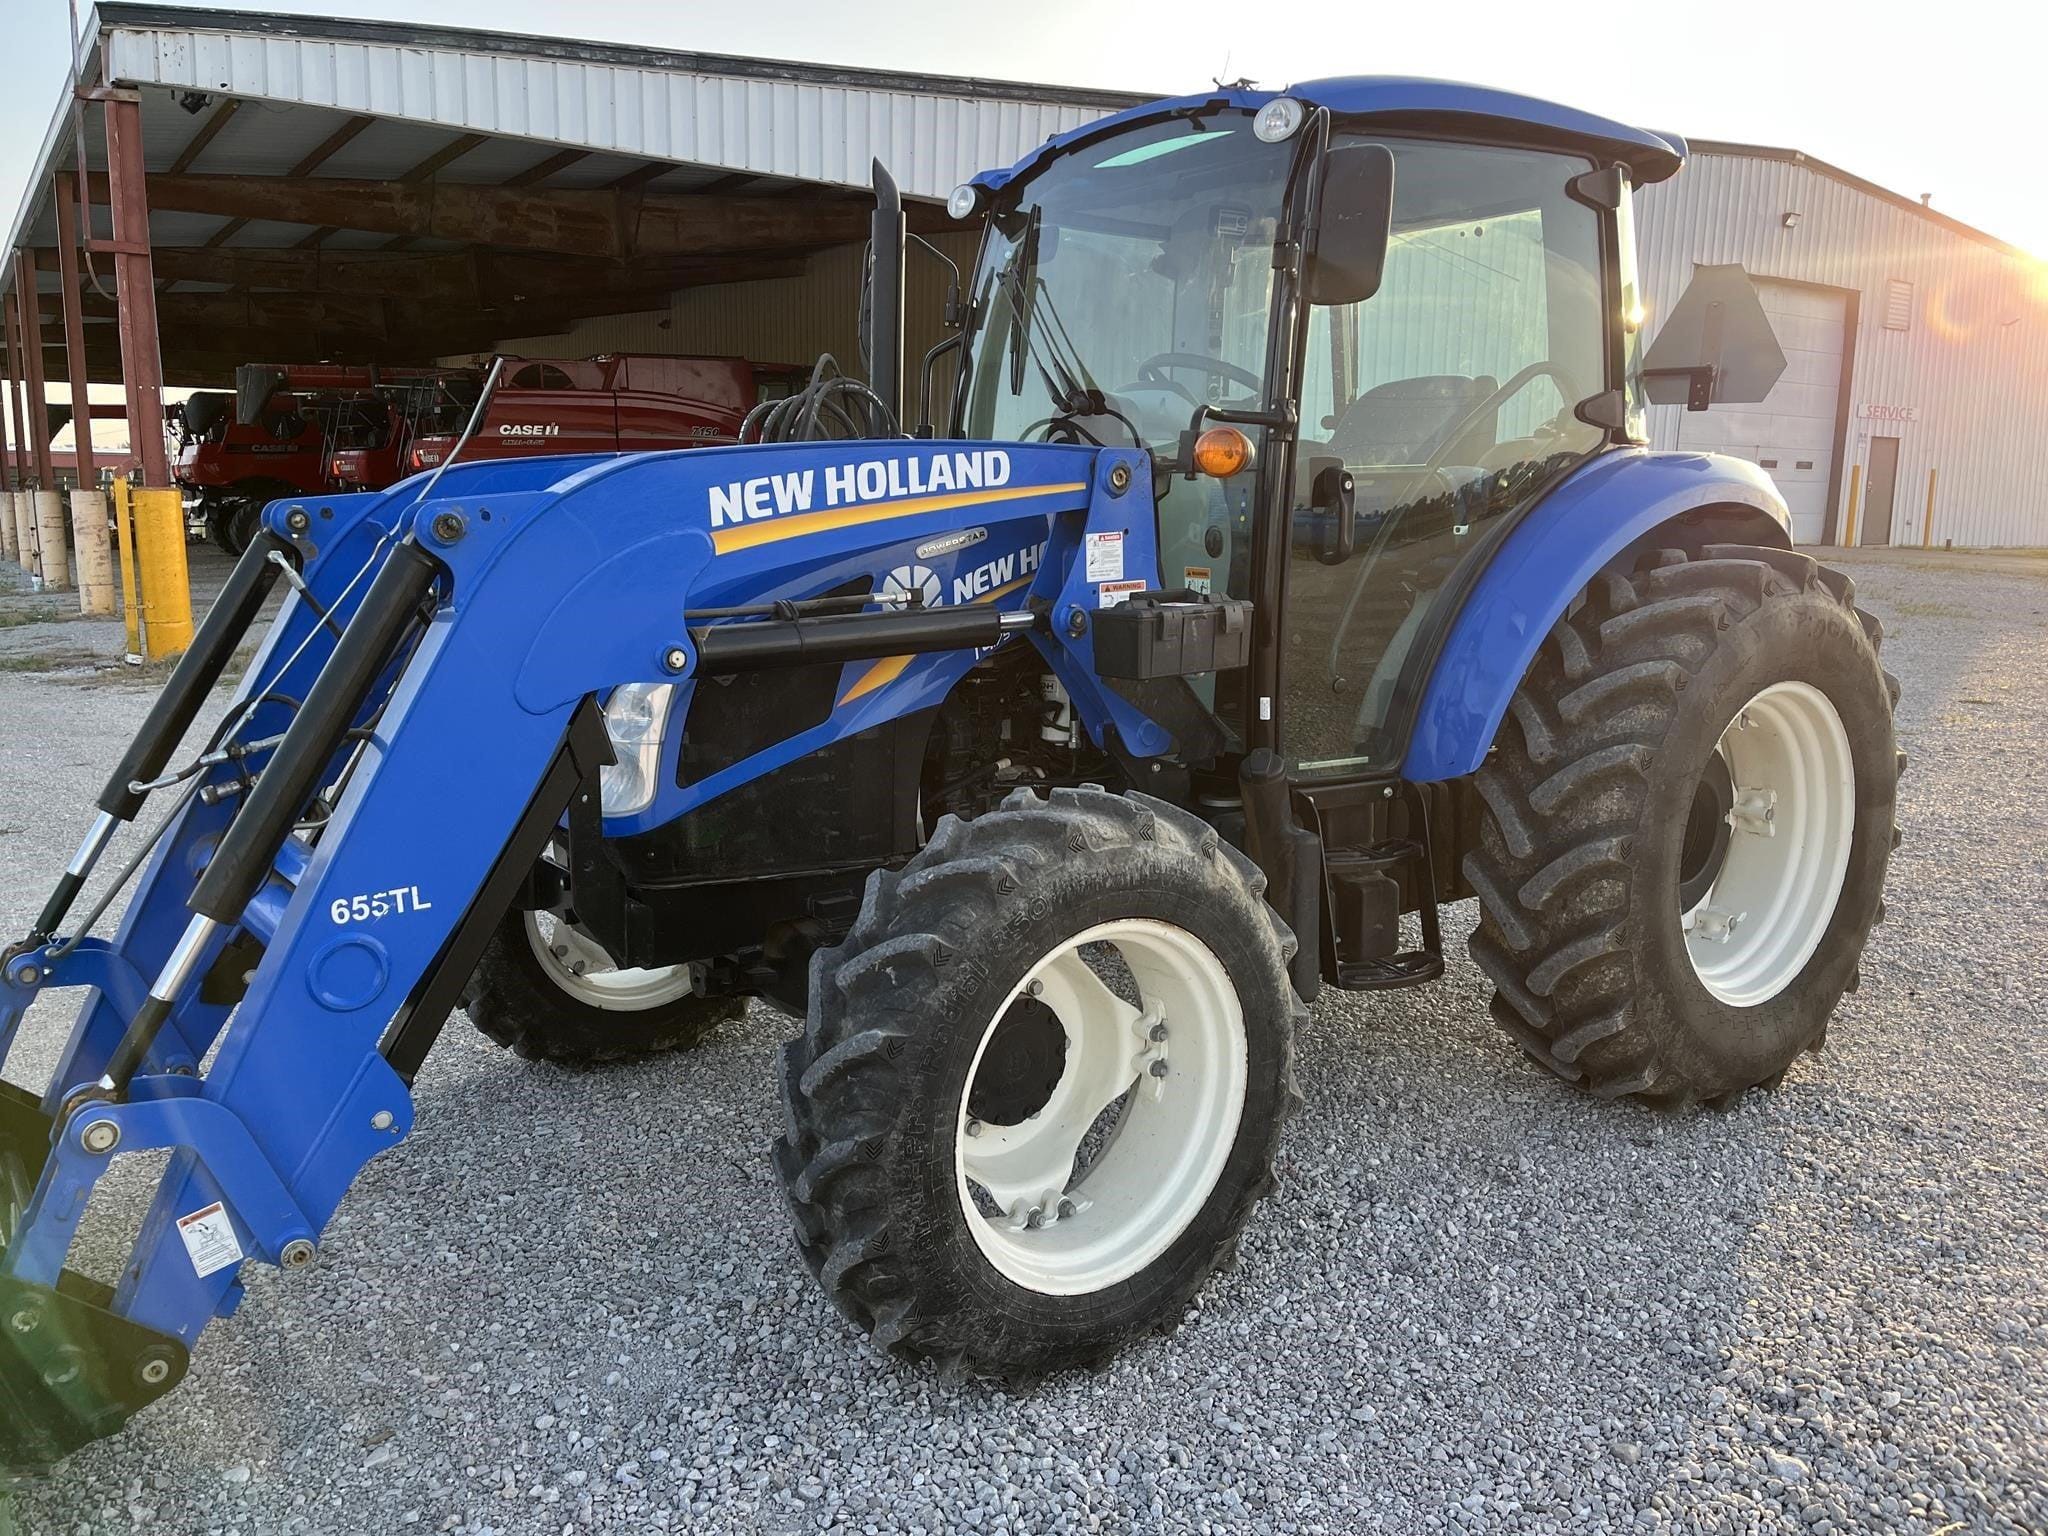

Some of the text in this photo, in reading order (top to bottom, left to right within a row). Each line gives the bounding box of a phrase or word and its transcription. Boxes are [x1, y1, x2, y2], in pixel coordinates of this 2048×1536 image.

[1867, 405, 1914, 420] SERVICE
[499, 424, 544, 435] CASE
[708, 450, 1011, 527] NEW HOLLAND
[920, 530, 986, 556] POWERSTAR
[953, 553, 1015, 606] NEW
[1112, 582, 1142, 591] WARNING
[331, 885, 432, 925] 655TL
